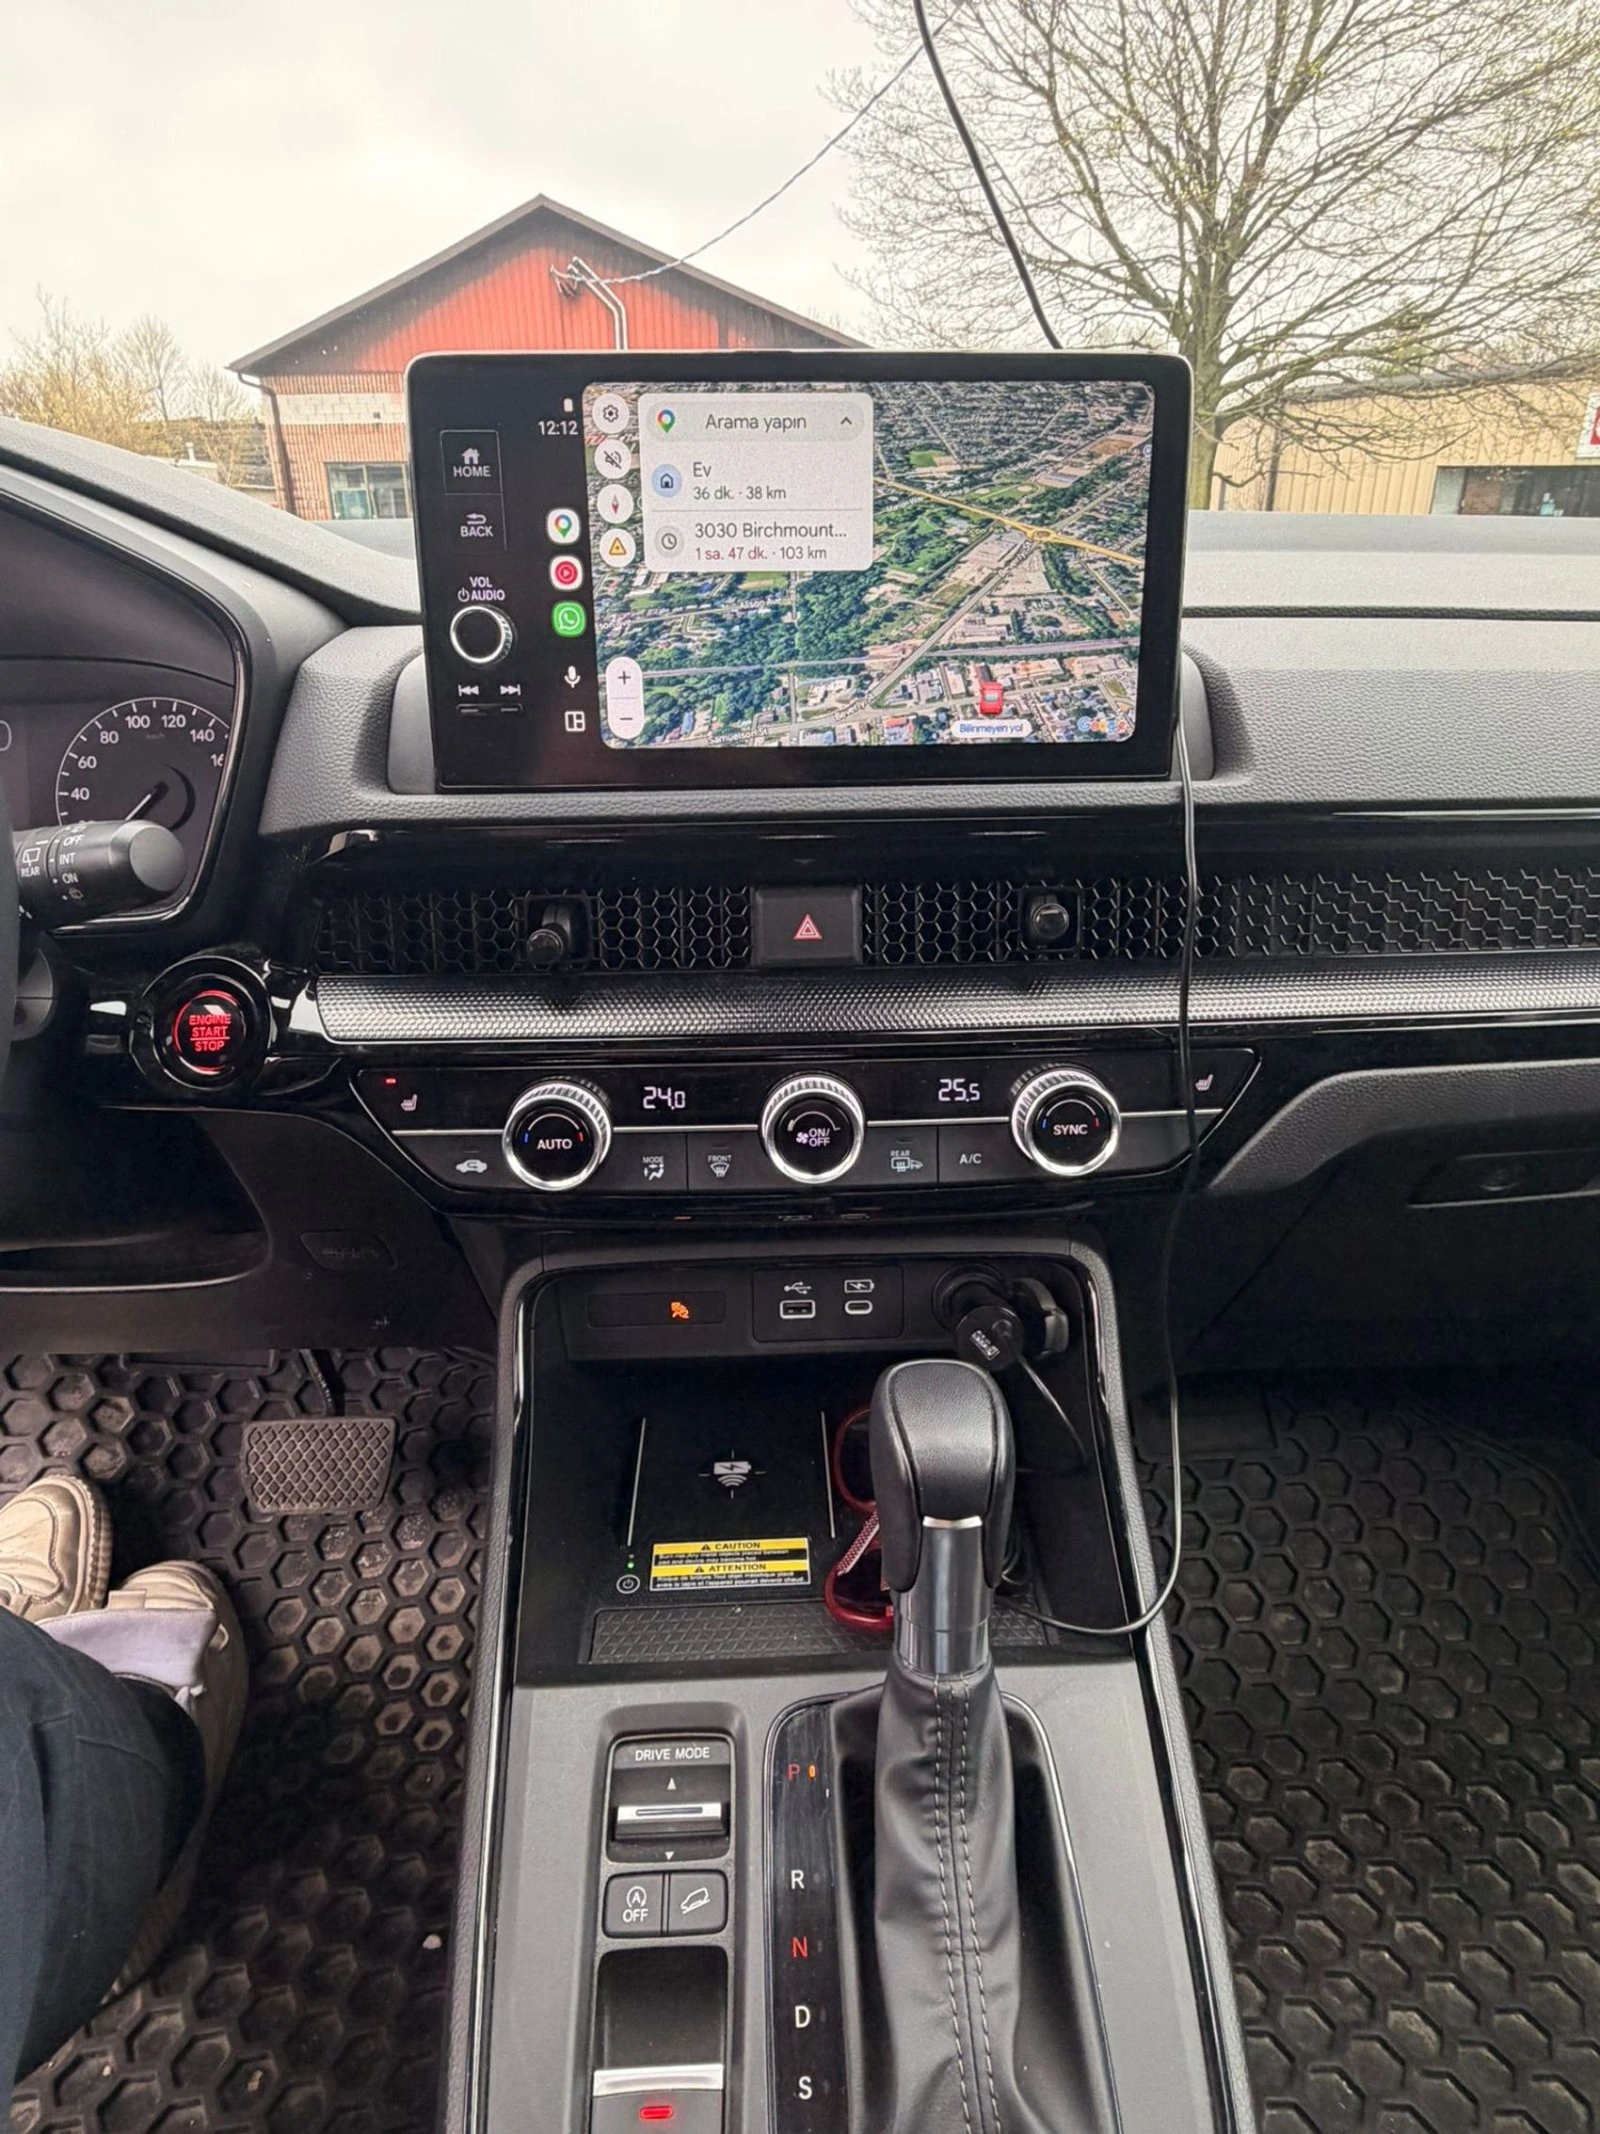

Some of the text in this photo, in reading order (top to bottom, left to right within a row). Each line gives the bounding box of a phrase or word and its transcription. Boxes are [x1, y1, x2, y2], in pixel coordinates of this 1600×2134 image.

[538, 421, 578, 436] 12:12
[705, 414, 807, 433] Arama yapın
[453, 466, 491, 477] HOME
[693, 462, 712, 477] Ev
[693, 486, 786, 500] 36 dk. 38 km
[460, 525, 493, 537] BACK
[695, 523, 847, 538] 3030 Birchmount...
[696, 547, 827, 560] 1 sa. 47 dk. 103 km
[469, 576, 492, 588] VOL
[471, 589, 505, 601] AUDIO
[125, 715, 150, 729] 100
[162, 714, 186, 728] 120
[959, 723, 1023, 734] Bilinmeyen yol
[100, 730, 119, 744] 80
[190, 729, 215, 742] 140
[708, 729, 768, 744] Samuelson St
[77, 755, 97, 769] 60
[211, 753, 224, 767] 16
[71, 787, 90, 801] 40
[63, 834, 84, 846] OFF
[59, 852, 75, 865] INT
[21, 866, 41, 878] REAR
[62, 872, 78, 884] ON
[189, 1014, 231, 1025] ENGINE
[192, 1026, 228, 1037] START
[195, 1040, 225, 1052] STOP
[938, 1078, 980, 1103] 25.5
[643, 1086, 685, 1110] 24.0
[809, 1128, 830, 1138] ON/
[1053, 1124, 1088, 1136] SYNC
[537, 1137, 573, 1151] AUTO
[809, 1136, 830, 1147] OFF
[642, 1156, 664, 1164] MODE
[708, 1154, 732, 1162] FRONT
[959, 1153, 982, 1165] A/C
[715, 1542, 761, 1551] CAUTION
[709, 1563, 766, 1573] ATTENTION
[635, 1747, 710, 1761] DRIVE MODE
[788, 1764, 800, 1780] P
[791, 1870, 805, 1889] R
[622, 1908, 648, 1923] OFF
[792, 1937, 808, 1958] N
[794, 2005, 811, 2028] D
[798, 2077, 813, 2100] S
